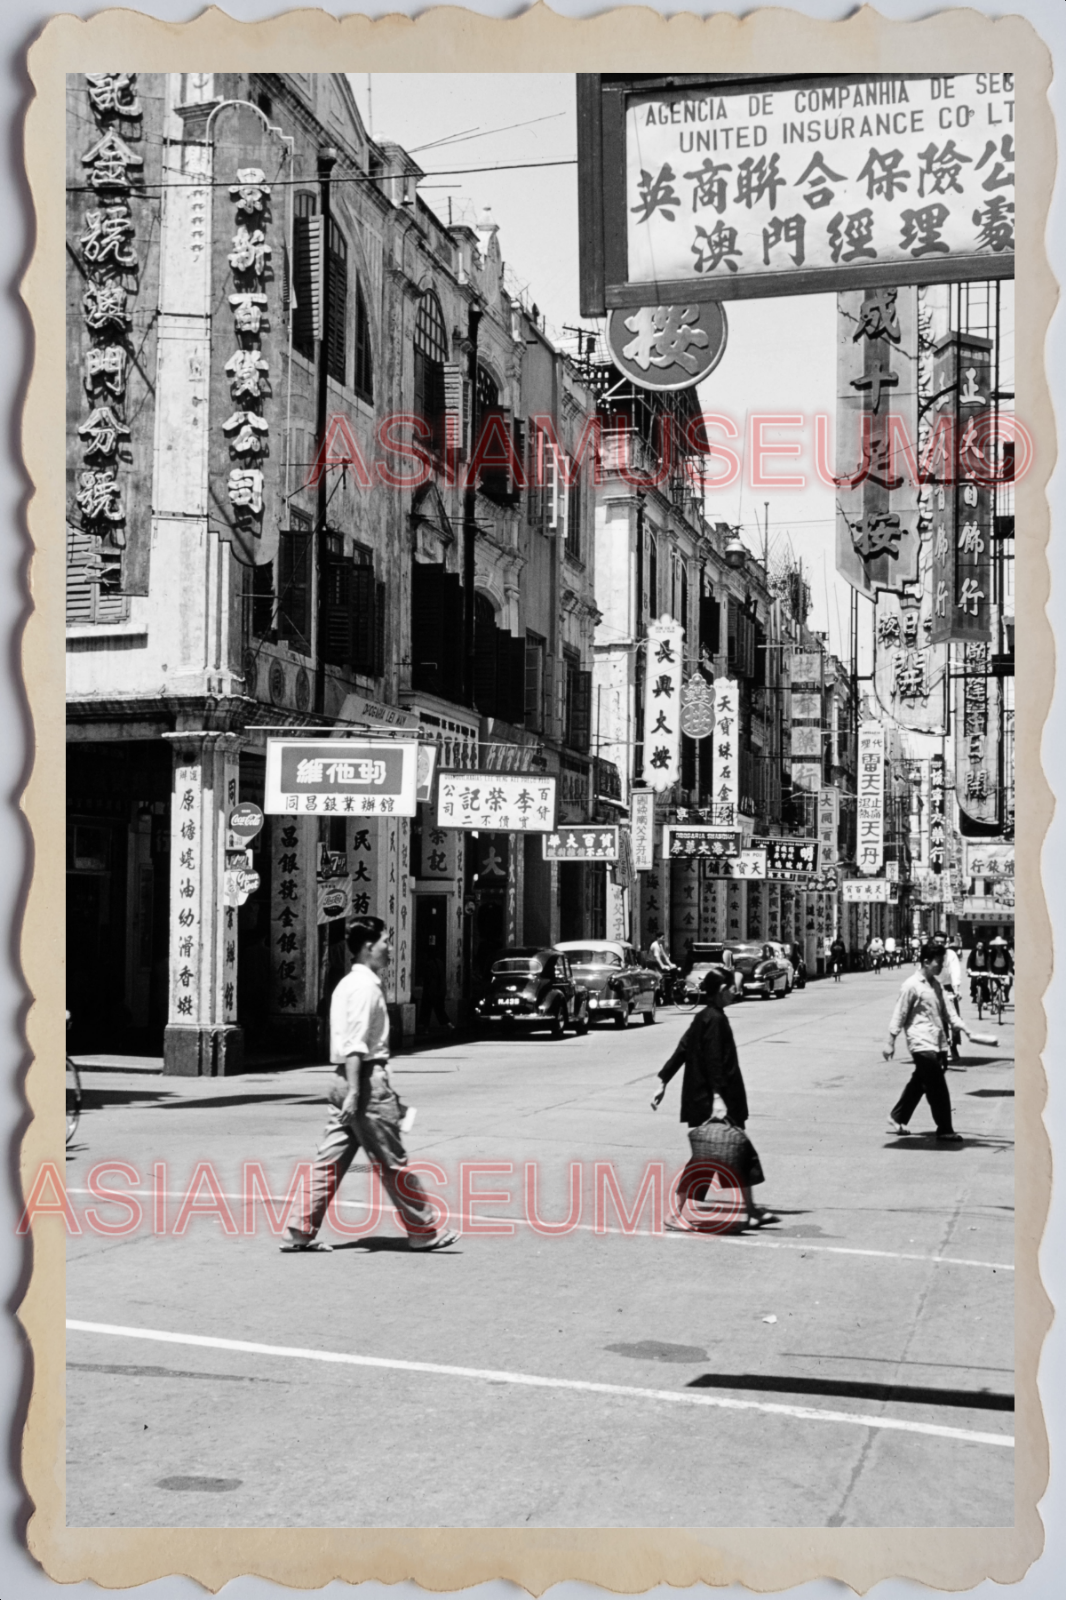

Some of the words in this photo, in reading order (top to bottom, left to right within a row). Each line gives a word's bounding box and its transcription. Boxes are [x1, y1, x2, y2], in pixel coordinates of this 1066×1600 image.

[645, 98, 727, 127] AGENCIA
[748, 94, 774, 117] DE
[794, 80, 910, 114] COMPANHIA
[931, 76, 956, 100] DE
[679, 125, 767, 154] UNITED
[782, 109, 924, 145] INSURANCE
